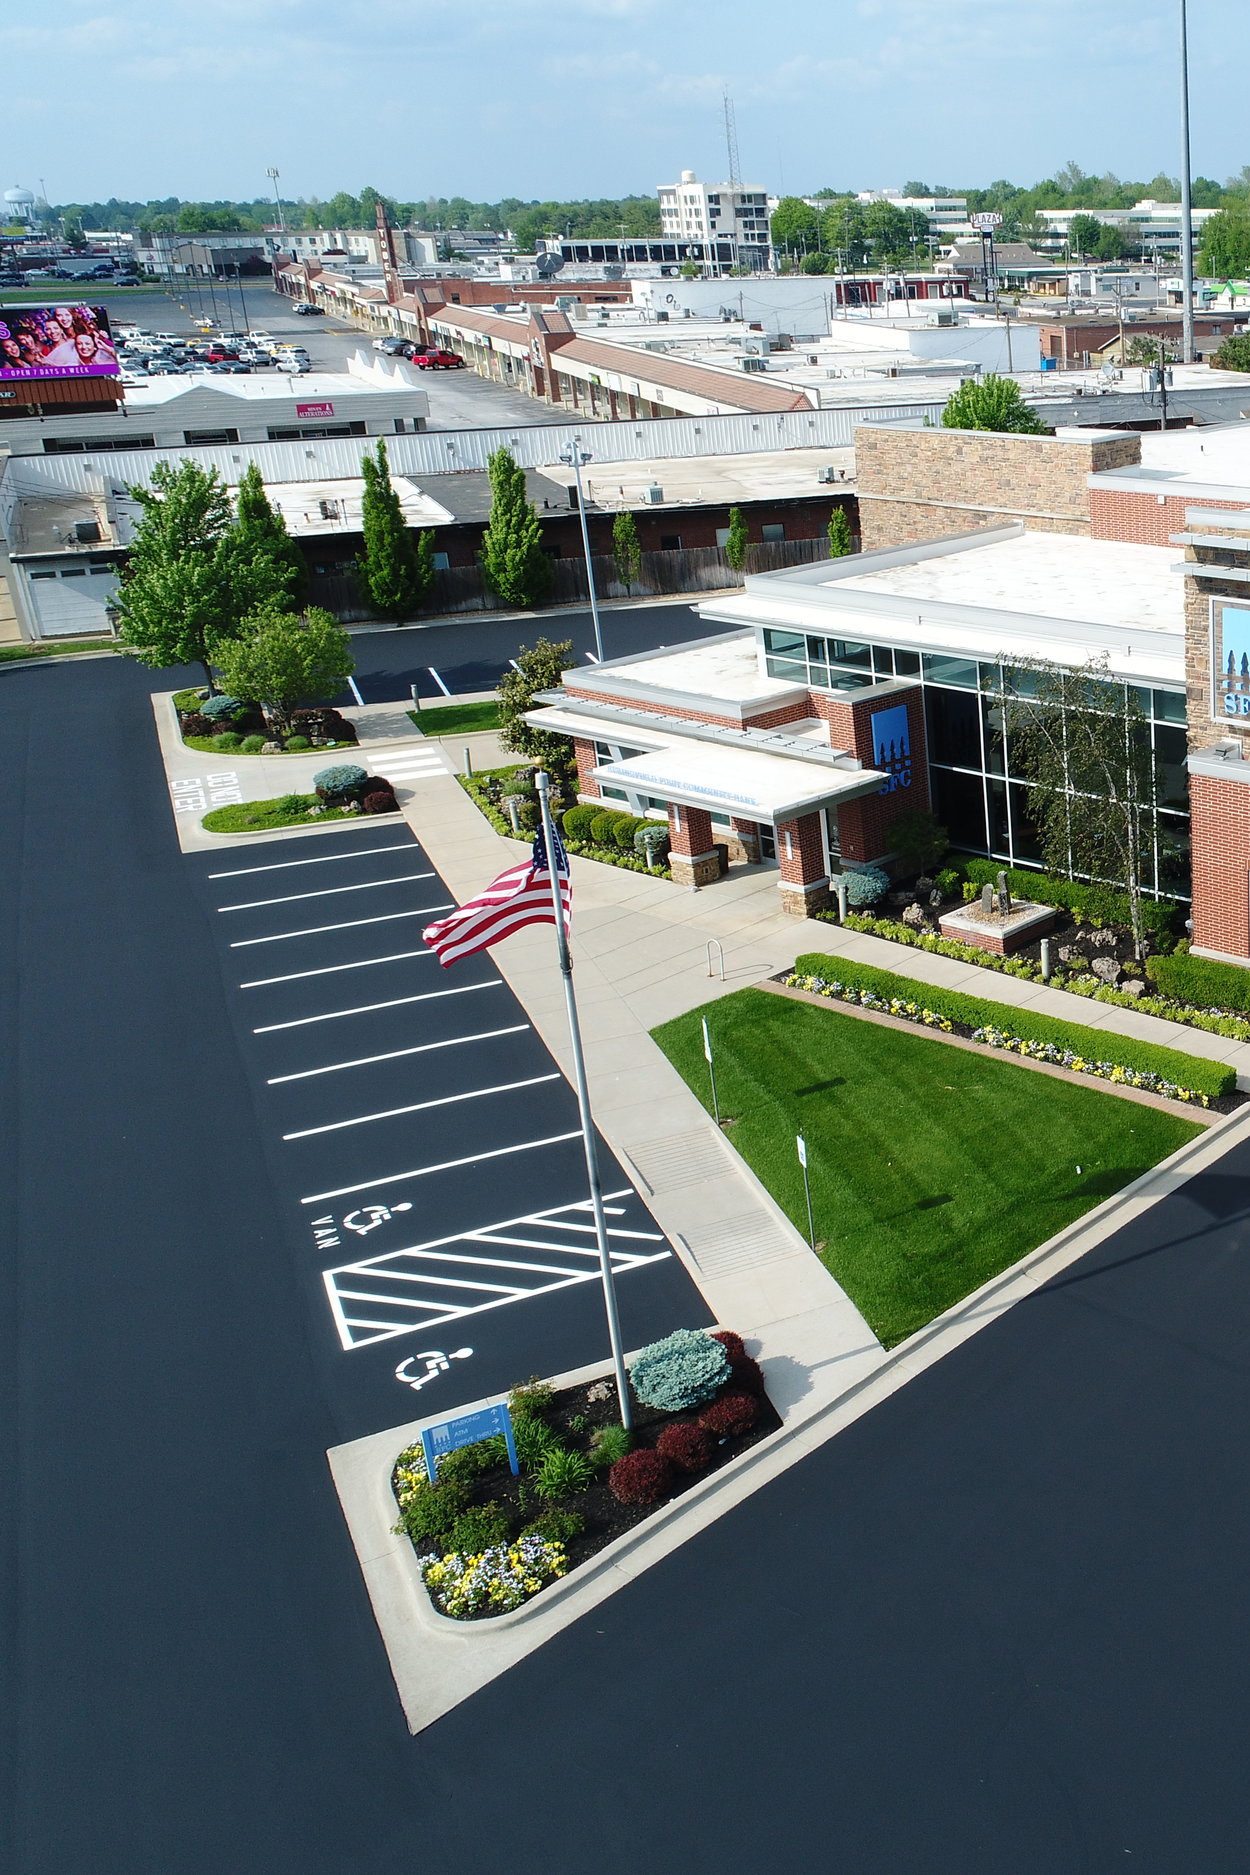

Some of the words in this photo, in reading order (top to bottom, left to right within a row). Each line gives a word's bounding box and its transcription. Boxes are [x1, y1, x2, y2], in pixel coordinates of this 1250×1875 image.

[10, 369, 31, 377] OPEN
[39, 367, 60, 376] DAYS
[68, 366, 90, 374] WEEK
[206, 771, 239, 787] DO
[171, 778, 208, 813] ENTER
[208, 785, 244, 807] NOT
[310, 1214, 341, 1250] VAN
[451, 1414, 481, 1429] PARKING
[454, 1428, 469, 1439] ATM
[455, 1435, 474, 1447] DRIVE
[476, 1429, 493, 1440] THRU
